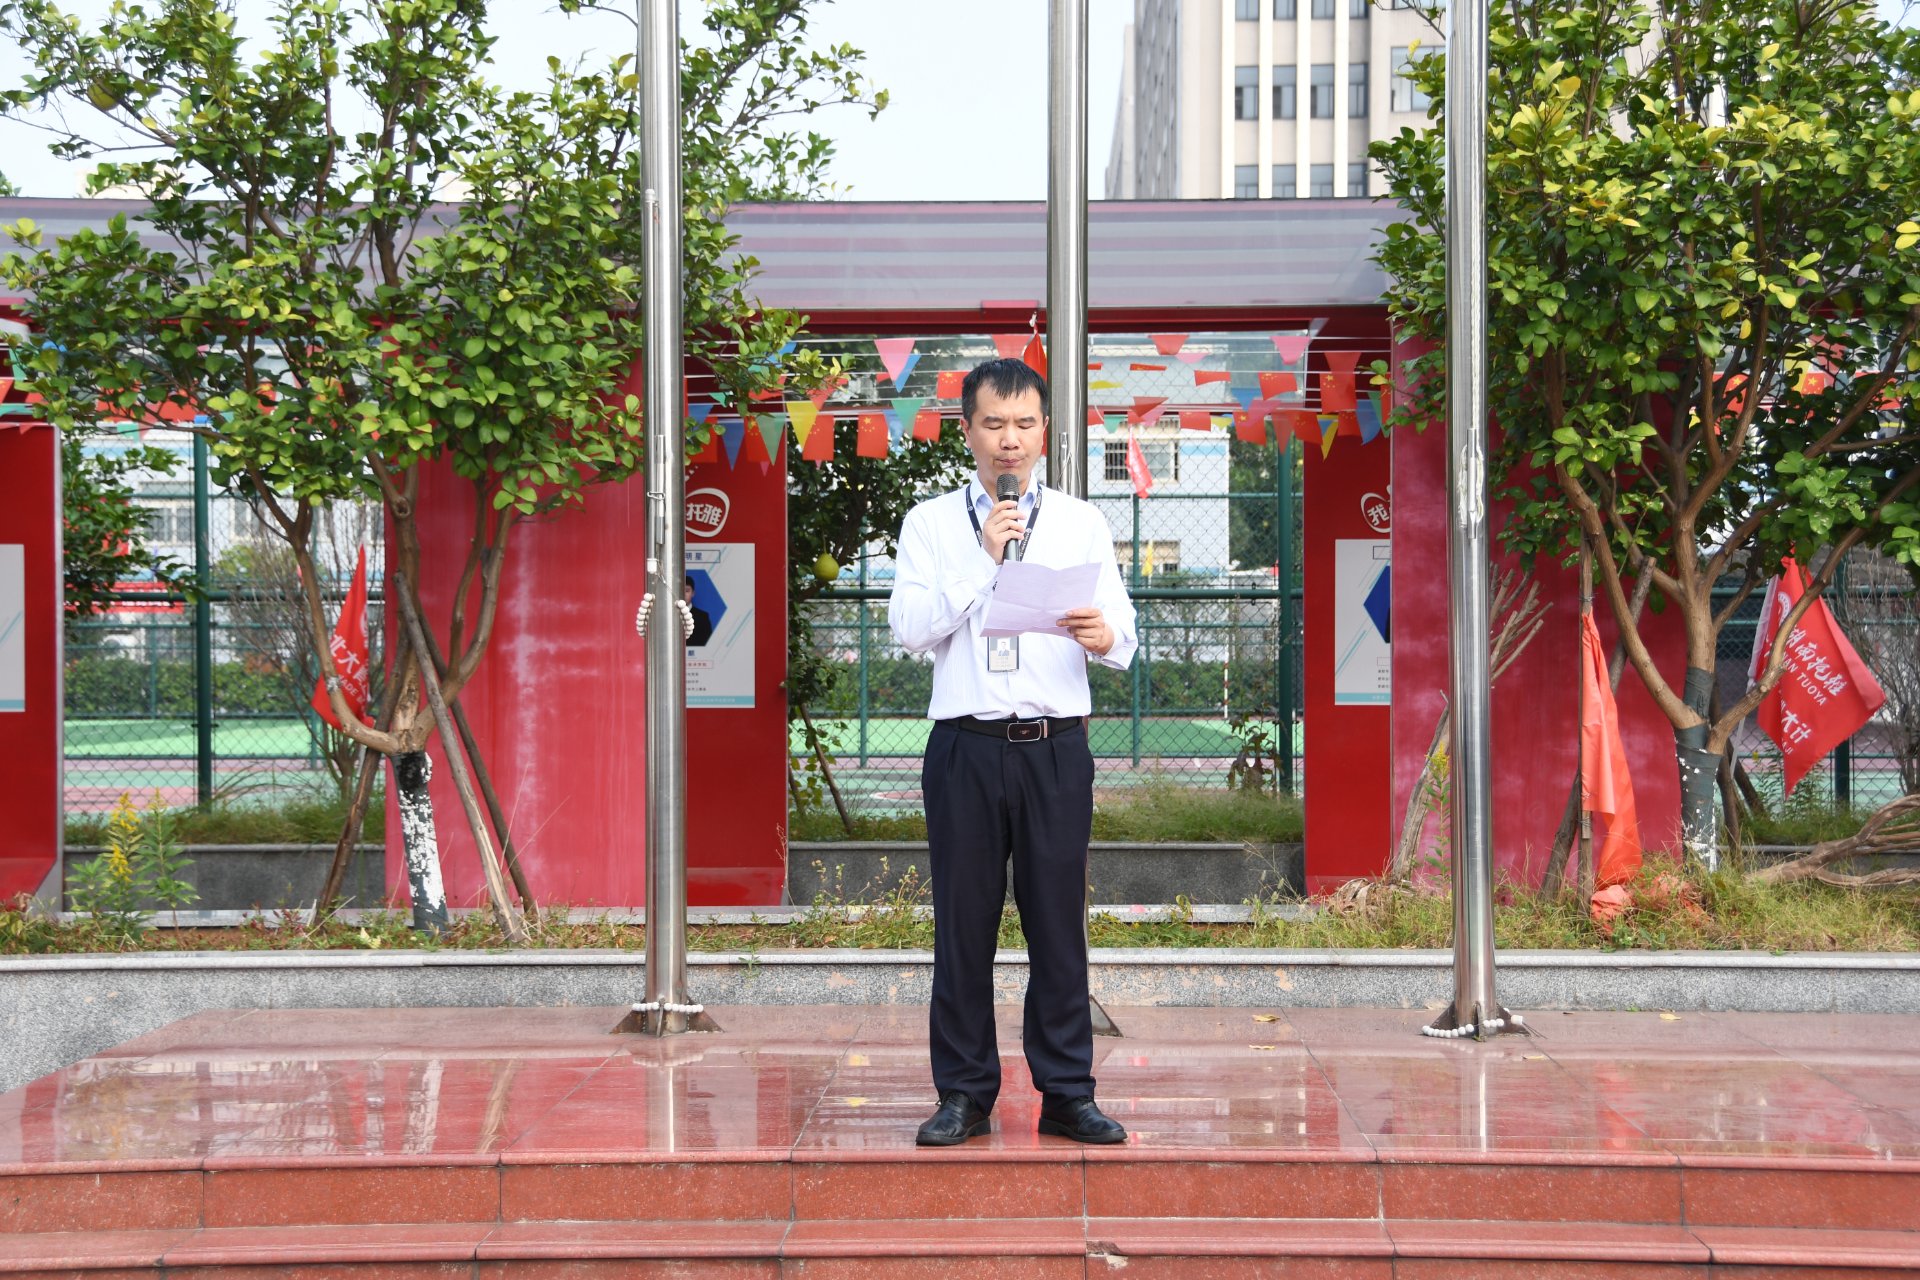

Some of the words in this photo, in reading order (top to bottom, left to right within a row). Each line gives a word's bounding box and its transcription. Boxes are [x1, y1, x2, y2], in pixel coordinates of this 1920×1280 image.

[686, 503, 722, 527] 托雅
[1367, 503, 1390, 526] 我
[1796, 671, 1827, 706] TUOYA
